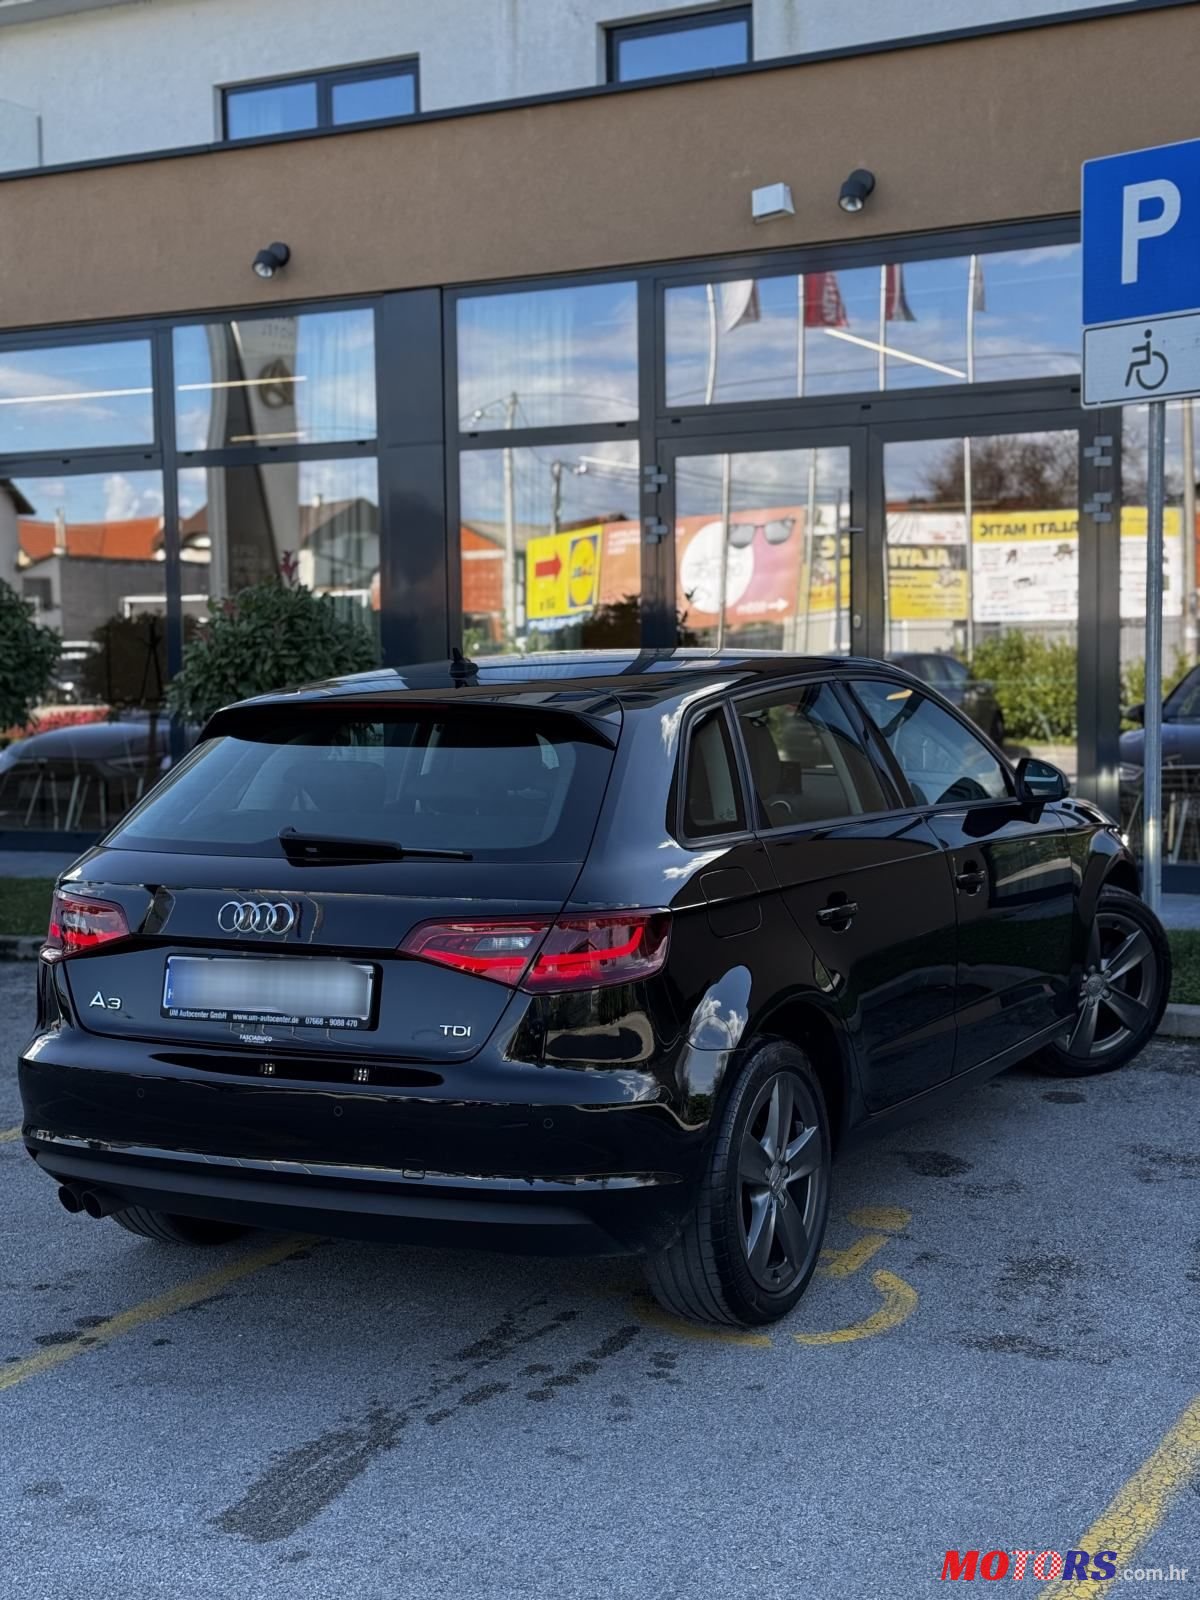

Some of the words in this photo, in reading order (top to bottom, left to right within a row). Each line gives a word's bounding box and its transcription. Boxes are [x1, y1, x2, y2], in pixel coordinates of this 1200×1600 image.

[1121, 178, 1181, 285] P
[89, 991, 121, 1010] A3
[180, 1010, 208, 1019] Autocenter
[210, 1011, 227, 1020] GmbH
[440, 1024, 471, 1037] TDI
